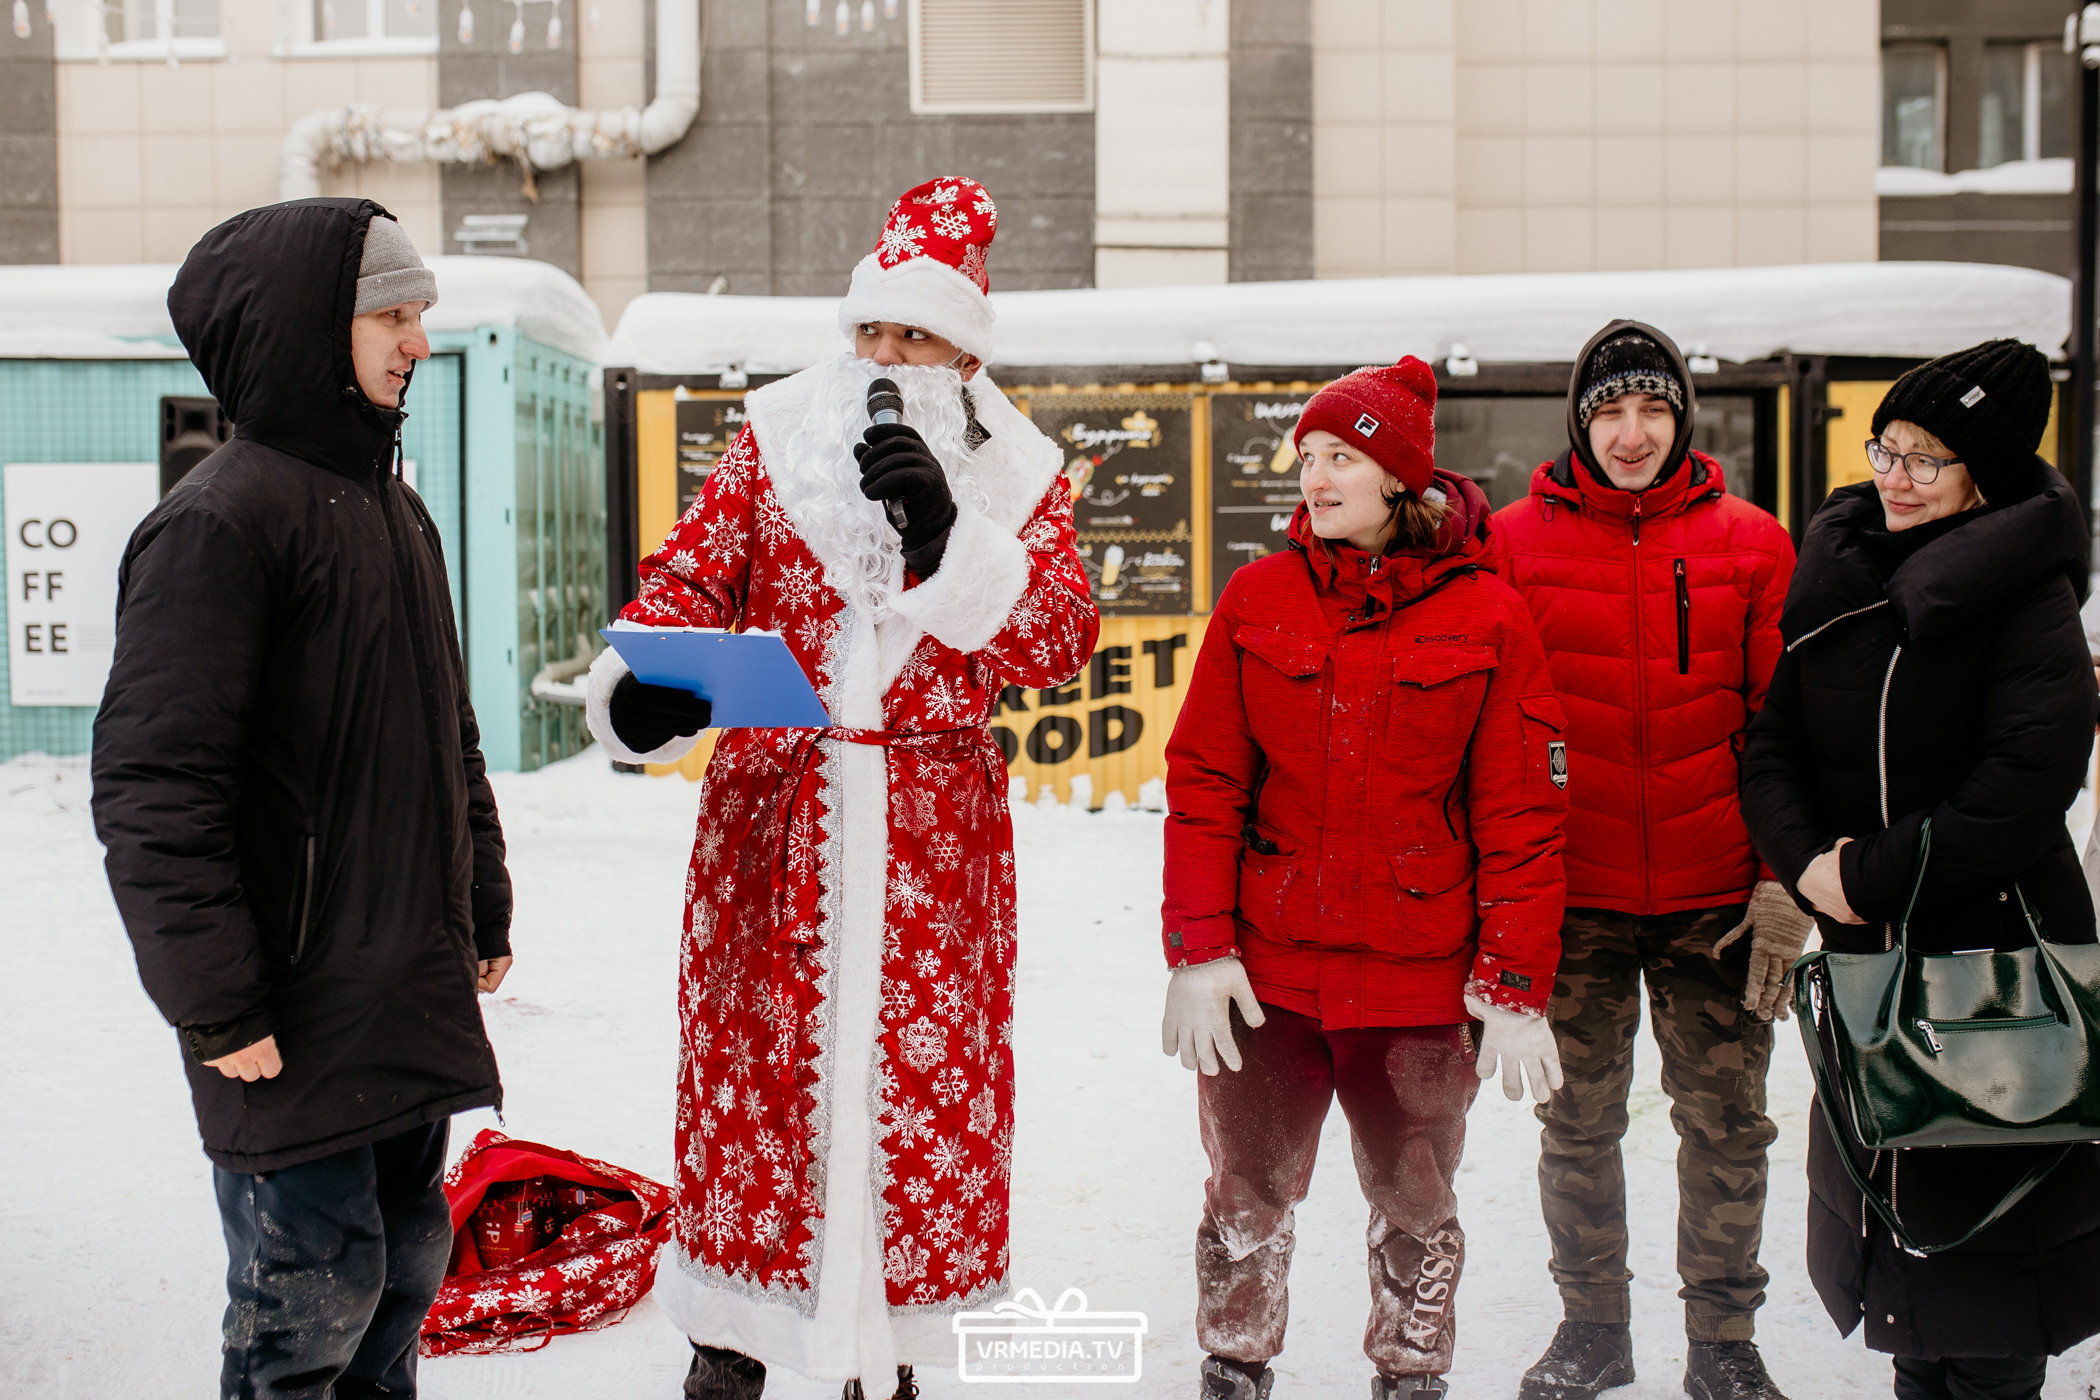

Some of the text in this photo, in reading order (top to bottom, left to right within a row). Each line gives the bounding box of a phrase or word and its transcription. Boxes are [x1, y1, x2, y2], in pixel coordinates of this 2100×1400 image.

[20, 518, 77, 548] CO
[23, 571, 63, 602] FF
[25, 623, 68, 653] EE
